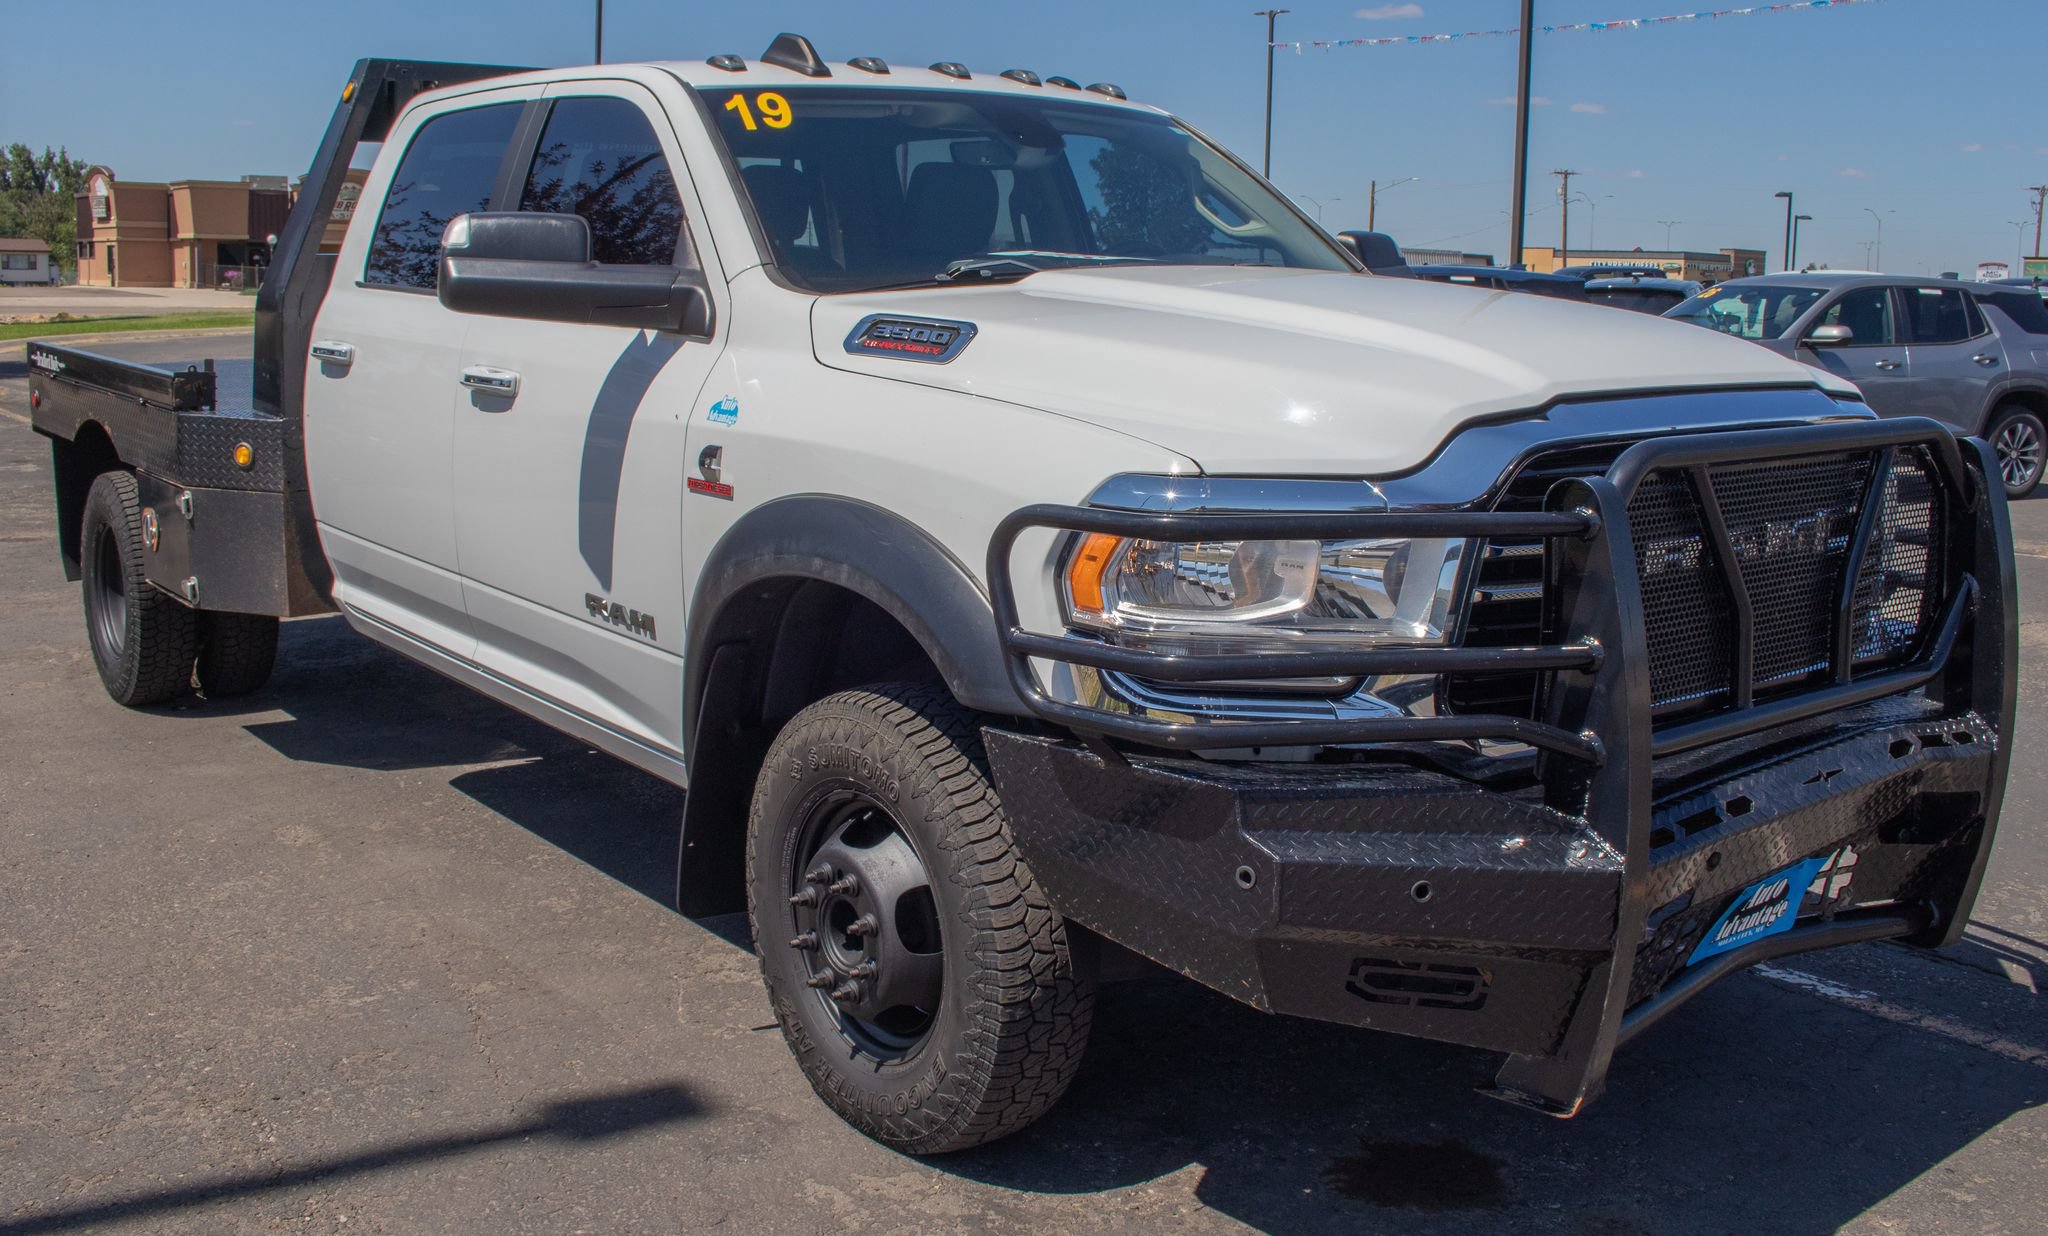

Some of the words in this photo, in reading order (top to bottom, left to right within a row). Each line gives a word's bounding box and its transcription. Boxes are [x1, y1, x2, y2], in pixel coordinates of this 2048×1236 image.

[724, 91, 793, 131] 19
[872, 324, 952, 346] 3500
[585, 592, 657, 641] RAM
[807, 742, 901, 804] SUMITOMO
[1741, 878, 1788, 912] Auto
[1711, 899, 1789, 944] Advantage
[816, 1051, 948, 1118] ENCOUNTER
